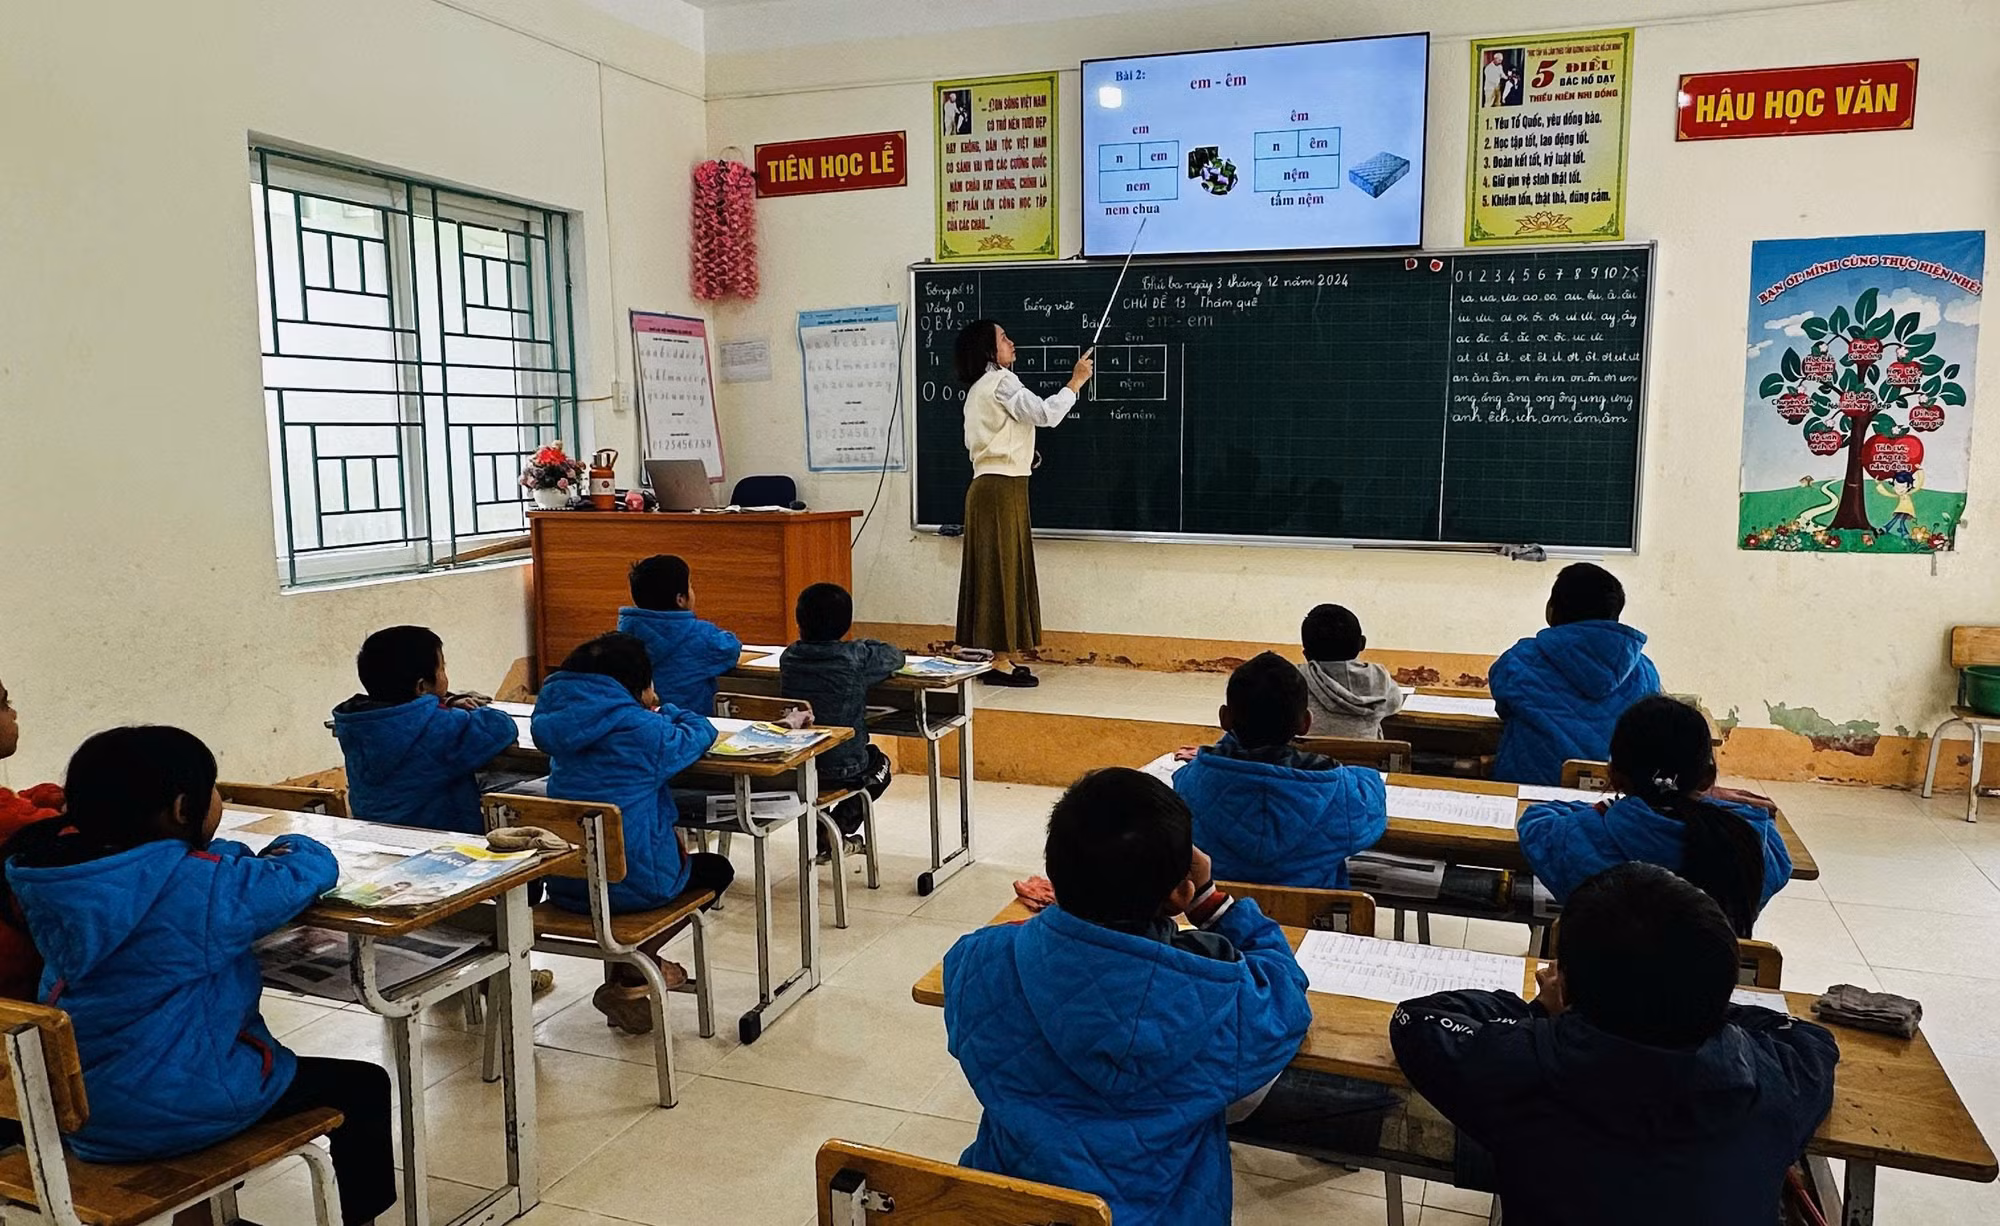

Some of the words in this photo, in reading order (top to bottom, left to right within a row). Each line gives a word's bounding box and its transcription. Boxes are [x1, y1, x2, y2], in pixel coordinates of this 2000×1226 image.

[1566, 56, 1613, 72] ĐIỀU
[1115, 70, 1133, 82] Bài
[1532, 59, 1558, 88] 5
[1560, 75, 1578, 86] BÁC
[1597, 74, 1615, 85] DẠY
[1190, 78, 1211, 90] em
[1226, 73, 1247, 87] êm
[1529, 92, 1552, 102] THIẾU
[1555, 91, 1575, 100] NIÊN
[1578, 91, 1591, 99] NHI
[1696, 87, 1755, 128] HẬU
[1765, 88, 1825, 124] HỌC
[1836, 78, 1898, 115] VĂN
[1291, 110, 1309, 122] êm
[1495, 116, 1509, 129] Yêu
[1547, 113, 1560, 128] yêu
[1132, 124, 1149, 135] em
[1273, 142, 1280, 151] n
[1310, 137, 1328, 149] êm
[1494, 137, 1508, 151] Học
[1555, 132, 1574, 148] động
[767, 154, 813, 183] TIÊN
[821, 153, 863, 182] HỌC
[870, 141, 894, 174] LỄ
[1116, 154, 1123, 163] n
[1150, 151, 1167, 162] em
[1515, 153, 1527, 167] kết
[1283, 169, 1310, 182] nệm
[1126, 181, 1150, 192] nem
[1271, 192, 1294, 207] tấm
[1298, 194, 1324, 206] nệm
[1105, 205, 1130, 216] nem
[1133, 203, 1160, 215] chua
[1169, 275, 1182, 288] ba
[1217, 277, 1222, 289] 3
[1268, 275, 1278, 287] 12
[1284, 276, 1314, 286] năm
[1318, 273, 1348, 287] 2024
[1455, 270, 1463, 282] 0
[1468, 270, 1472, 282] 1
[1480, 269, 1486, 282] 2
[1495, 269, 1500, 282] 3
[1508, 269, 1515, 284] 4
[1523, 268, 1530, 281] 5
[1538, 269, 1545, 280] 6
[1556, 269, 1563, 280] 7
[1575, 268, 1581, 280] 8
[1591, 267, 1598, 279] 9
[1605, 267, 1617, 279] 10
[1759, 283, 1784, 303] BẠN
[1806, 262, 1838, 279] MÌNH
[1842, 254, 1878, 267] CÙNG
[1882, 257, 1916, 270] THỰC
[1918, 262, 1950, 279] HIỆN
[966, 284, 974, 294] 13
[1175, 297, 1185, 308] 13
[1237, 297, 1257, 311] quê
[1104, 318, 1111, 327] 2
[1110, 406, 1130, 419] tấm
